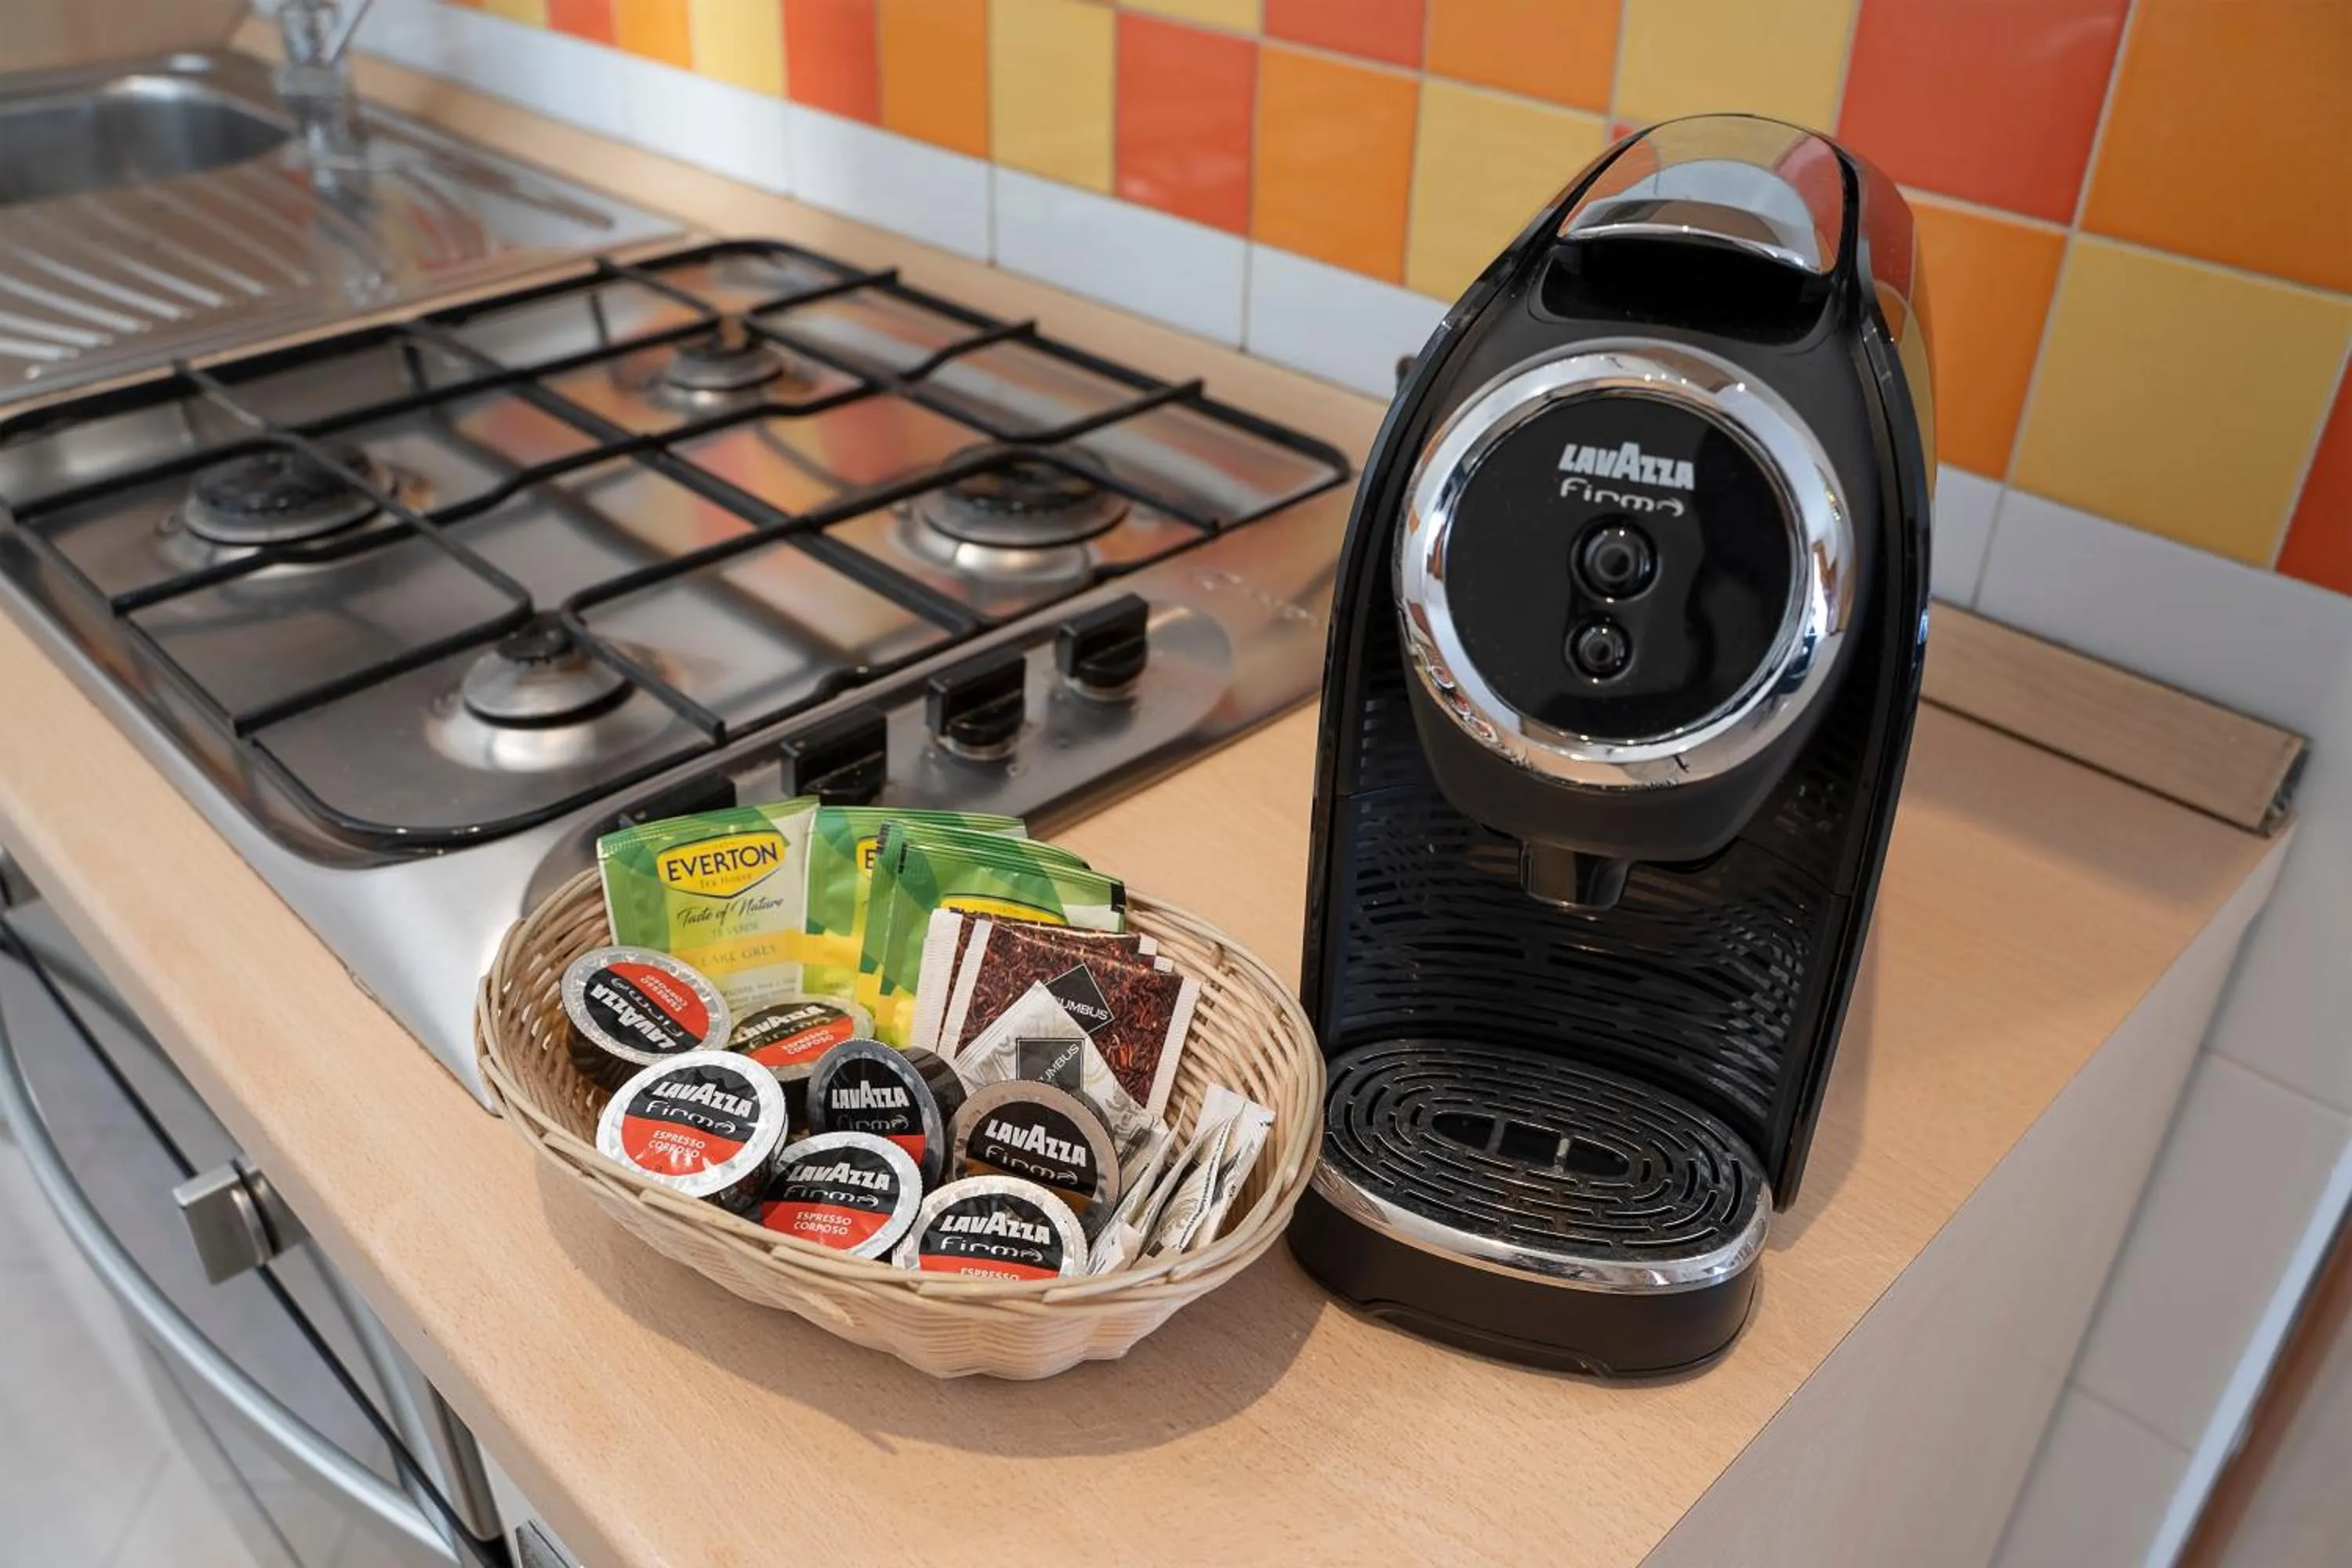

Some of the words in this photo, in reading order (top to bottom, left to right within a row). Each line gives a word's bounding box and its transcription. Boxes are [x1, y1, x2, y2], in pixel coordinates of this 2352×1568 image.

[1558, 441, 1695, 491] LAVAZZA
[666, 840, 779, 882] EVERTON
[677, 906, 713, 929] Taste
[715, 902, 729, 926] of
[730, 898, 784, 916] Nature
[590, 982, 677, 1049] LAVAZZA
[734, 1004, 827, 1044] LAVAZZA
[1056, 996, 1109, 1020] UMBUS
[1039, 1044, 1080, 1081] UMBUS
[652, 1081, 753, 1118] LAVAZZA
[832, 1080, 909, 1109] LAVAZZA
[652, 1130, 706, 1149] ESPRESSO
[985, 1119, 1087, 1167] LAVAZZA
[786, 1162, 891, 1191] LAVAZZA
[796, 1210, 852, 1226] ESPRESSO
[939, 1211, 1051, 1245] LAVAZZA
[960, 1267, 1020, 1280] ESPRESSO
